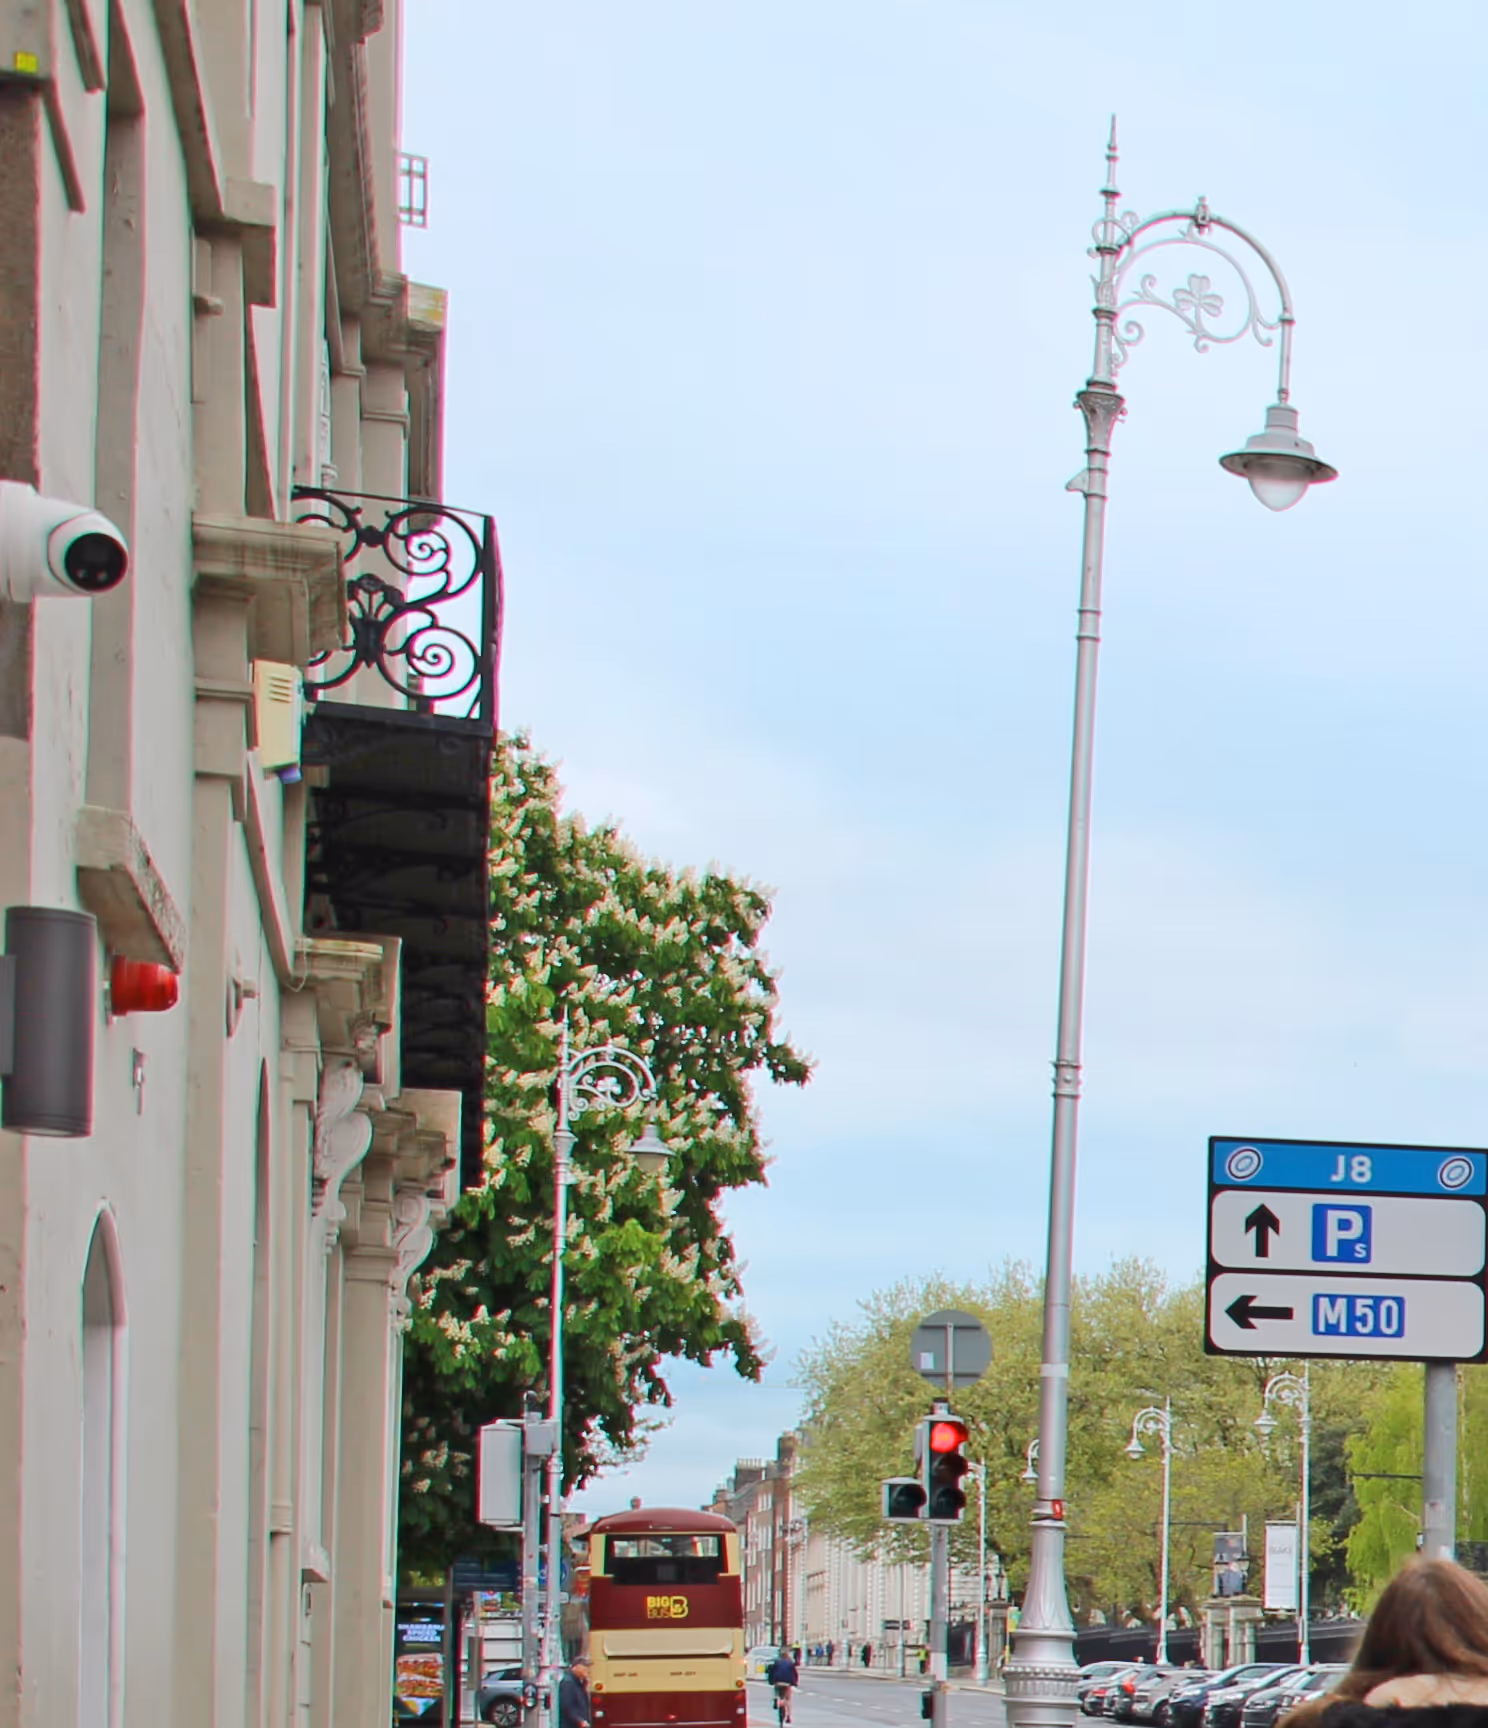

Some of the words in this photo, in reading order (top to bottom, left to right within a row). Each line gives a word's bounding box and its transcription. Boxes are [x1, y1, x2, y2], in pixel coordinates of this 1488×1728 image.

[1330, 1154, 1372, 1183] J8
[1318, 1297, 1399, 1335] M50
[647, 1596, 670, 1608] BIG
